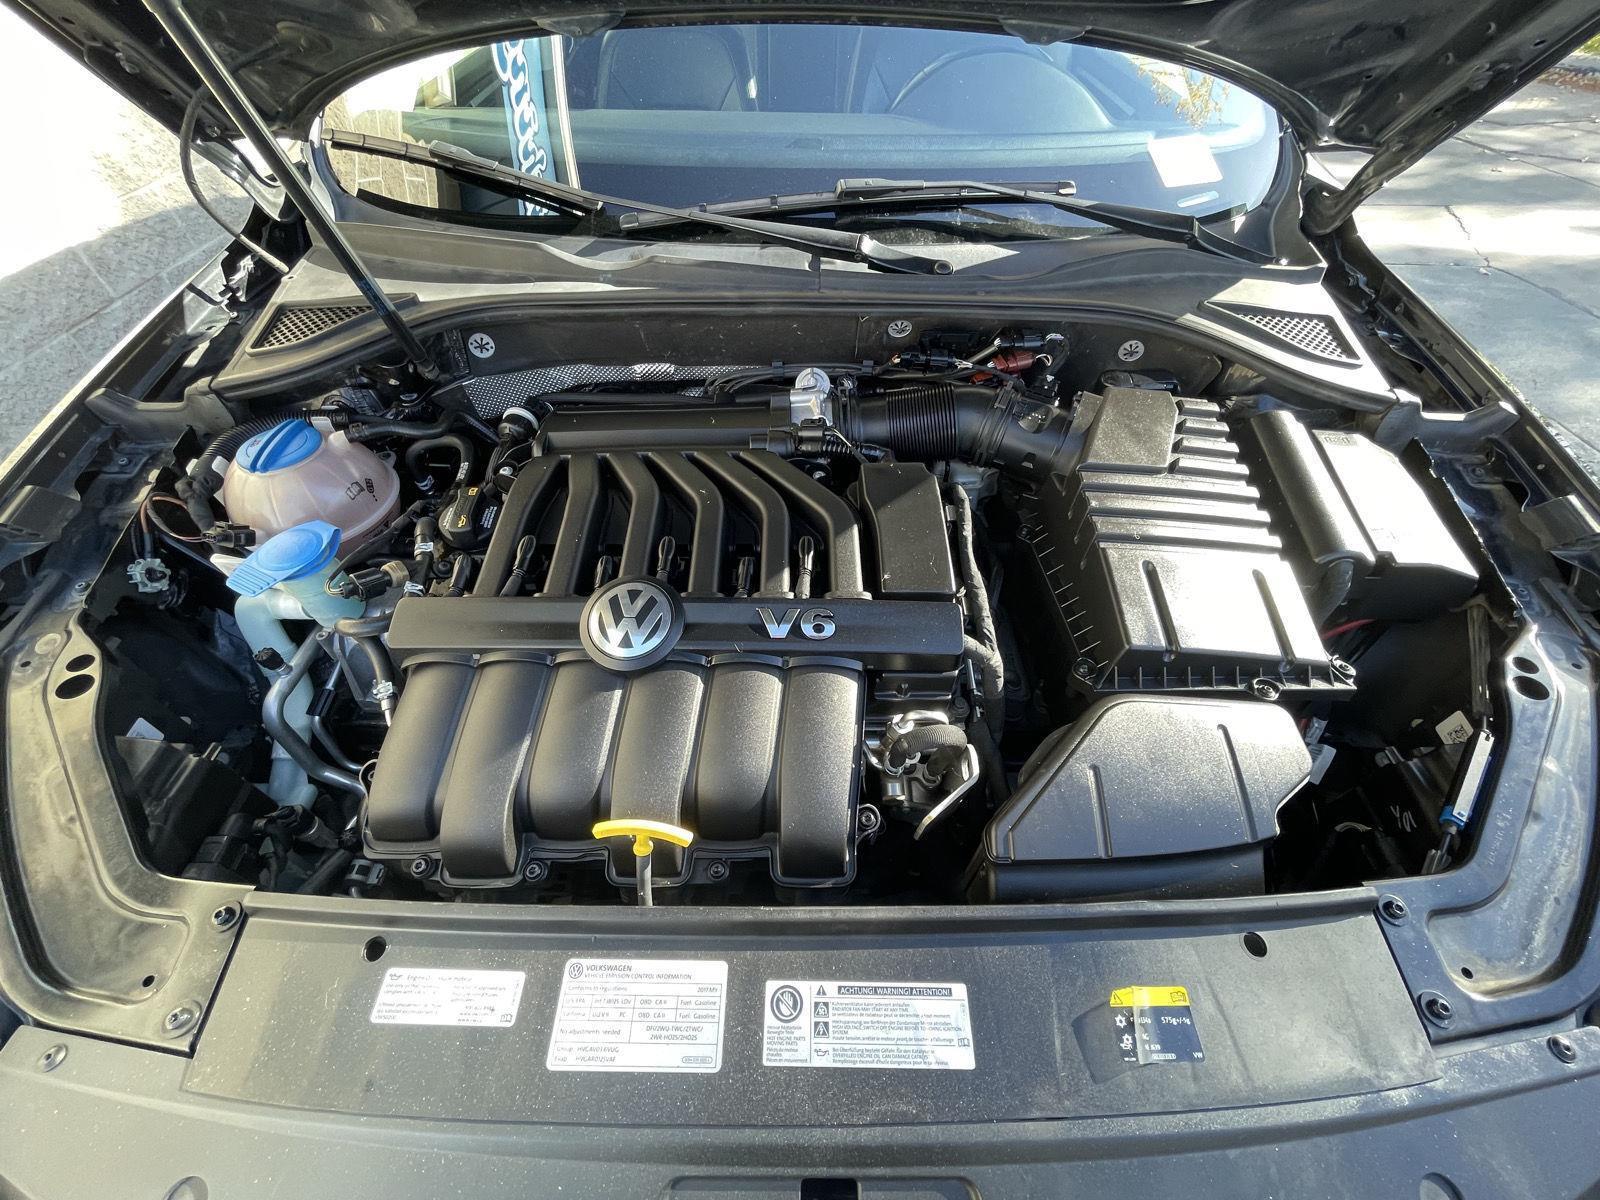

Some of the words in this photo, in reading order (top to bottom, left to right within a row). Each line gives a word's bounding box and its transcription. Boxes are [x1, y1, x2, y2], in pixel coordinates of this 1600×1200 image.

[757, 608, 836, 640] V6
[586, 964, 632, 972] VOLKSWAGEN
[841, 987, 874, 995] ACHTUNG!
[912, 988, 950, 996] ATTENTION!
